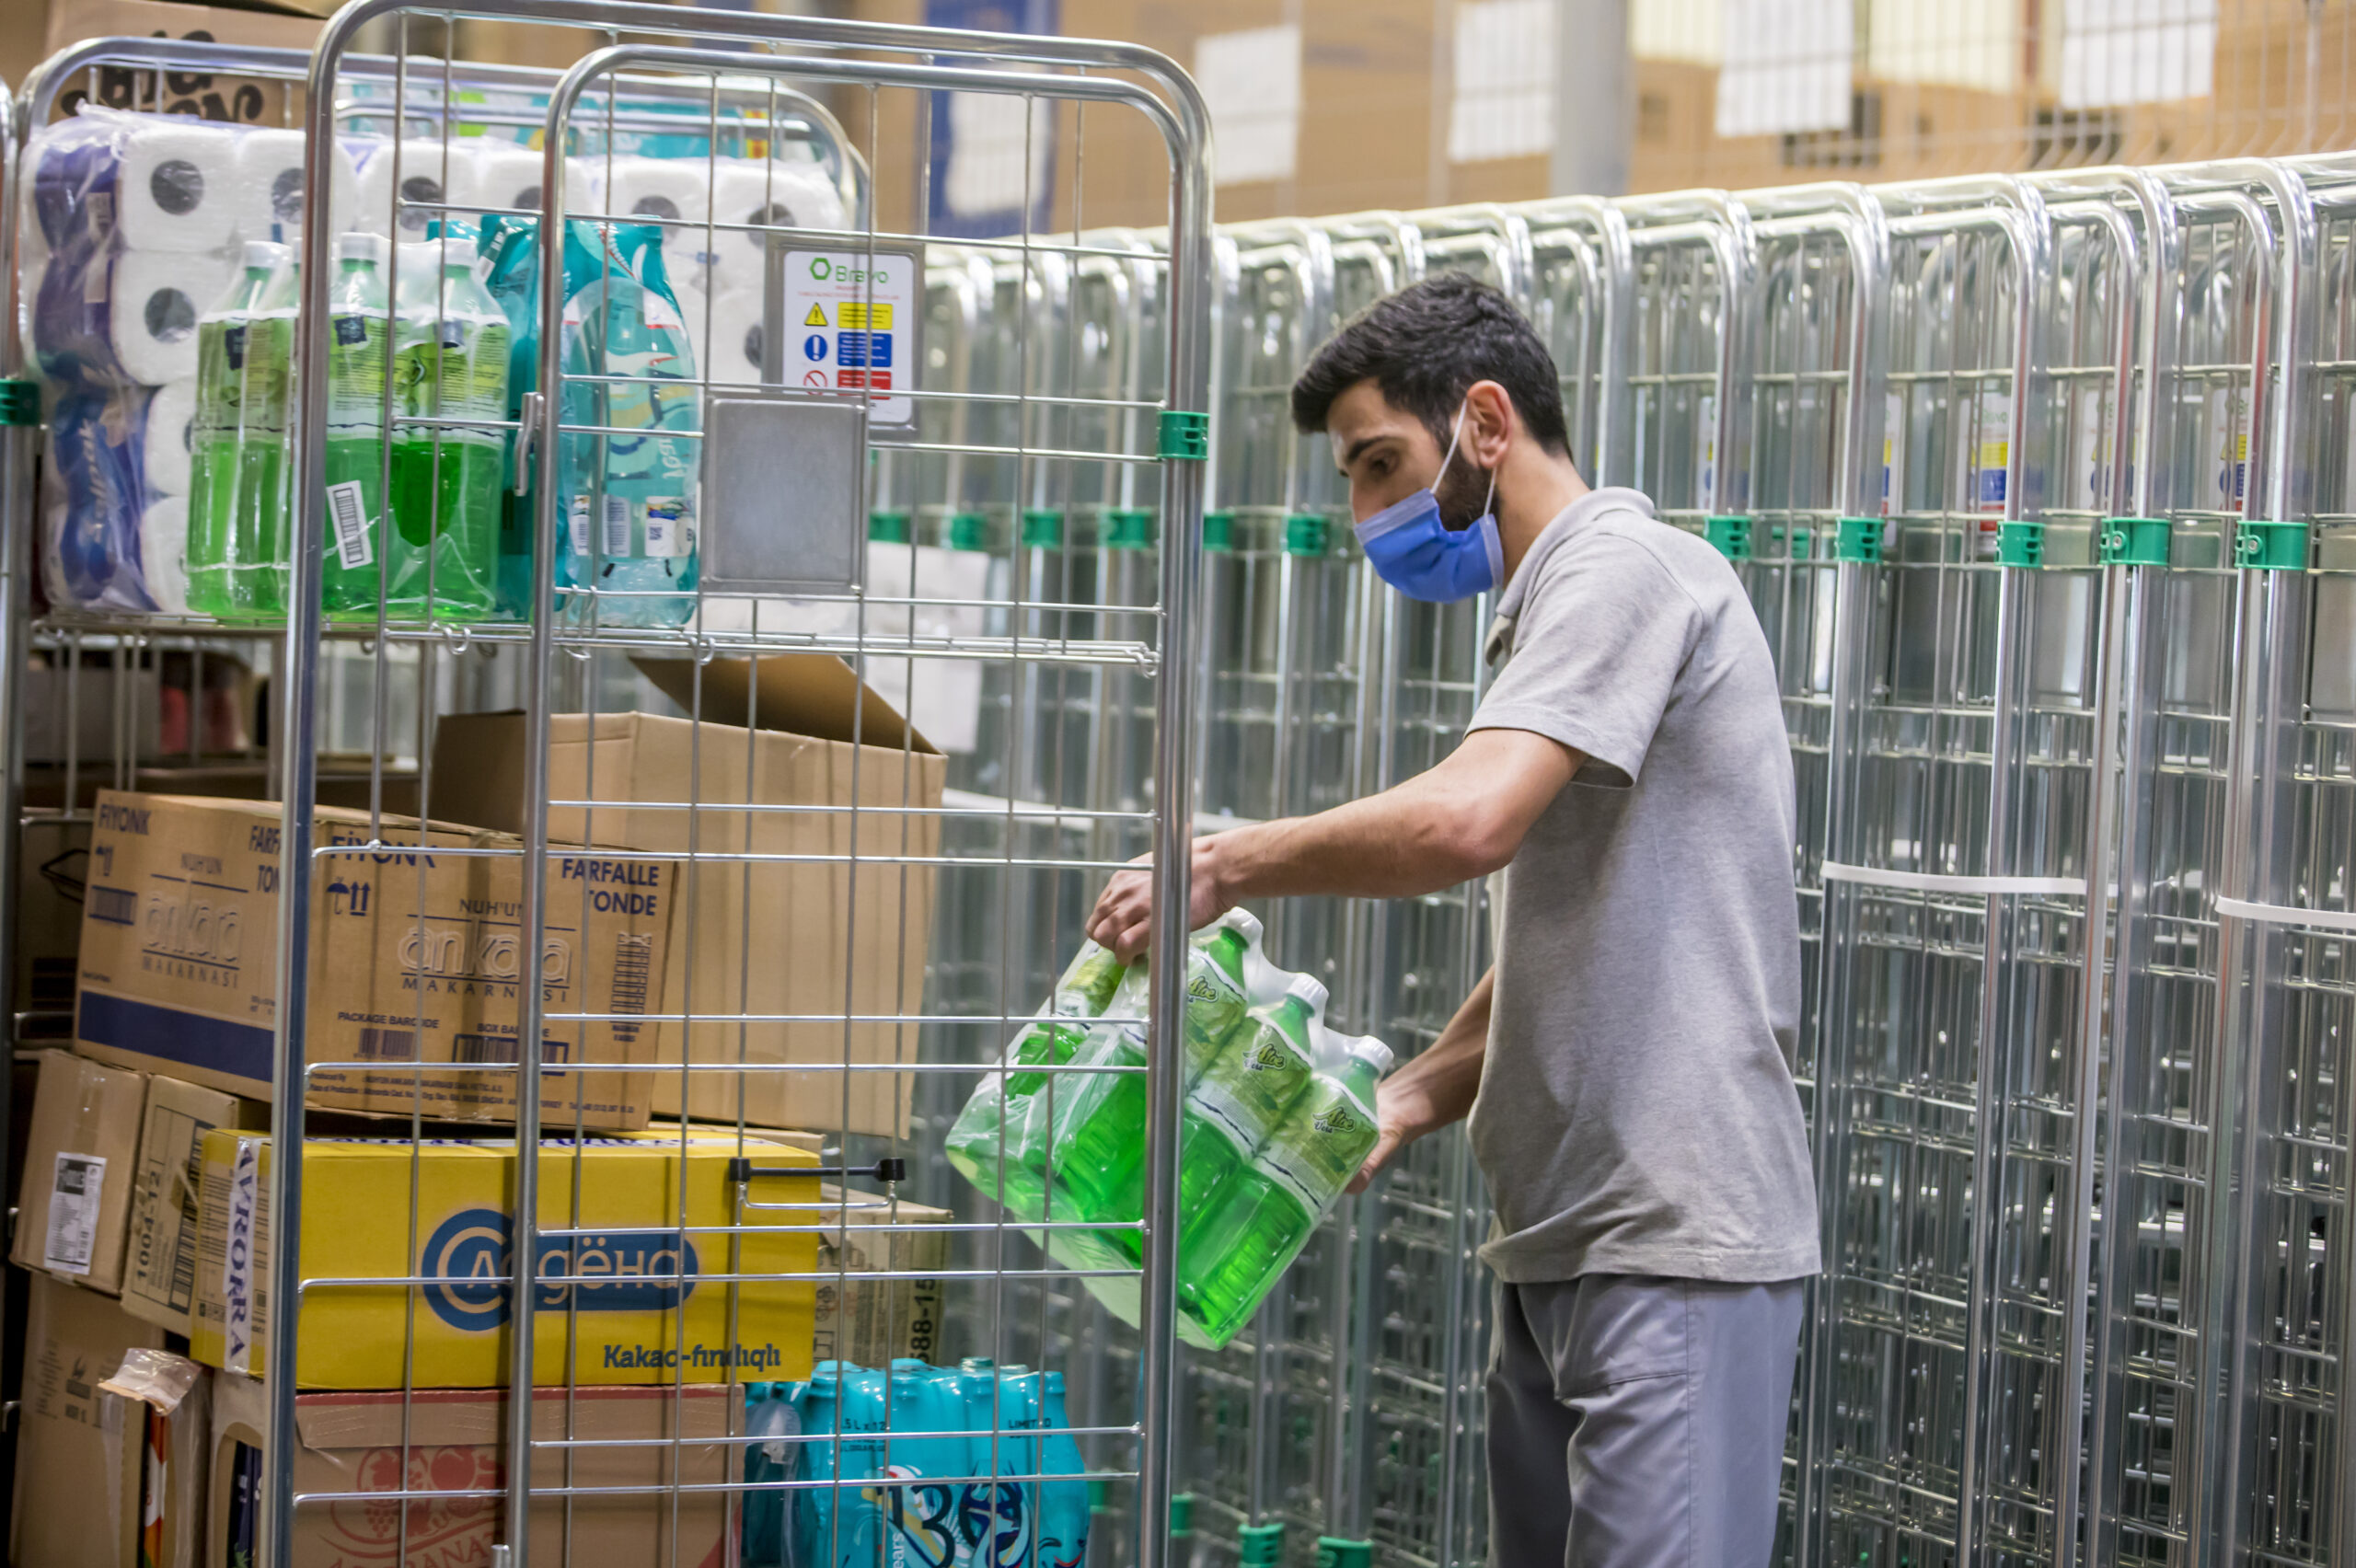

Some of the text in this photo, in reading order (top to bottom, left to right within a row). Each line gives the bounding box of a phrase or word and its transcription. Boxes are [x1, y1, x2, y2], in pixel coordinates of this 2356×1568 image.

[561, 858, 660, 887] FARFALLE
[398, 927, 572, 986] ankaa
[402, 977, 566, 1003] MAKARNSI
[1009, 1418, 1052, 1429] LIMITD
[892, 1531, 906, 1568] ears
